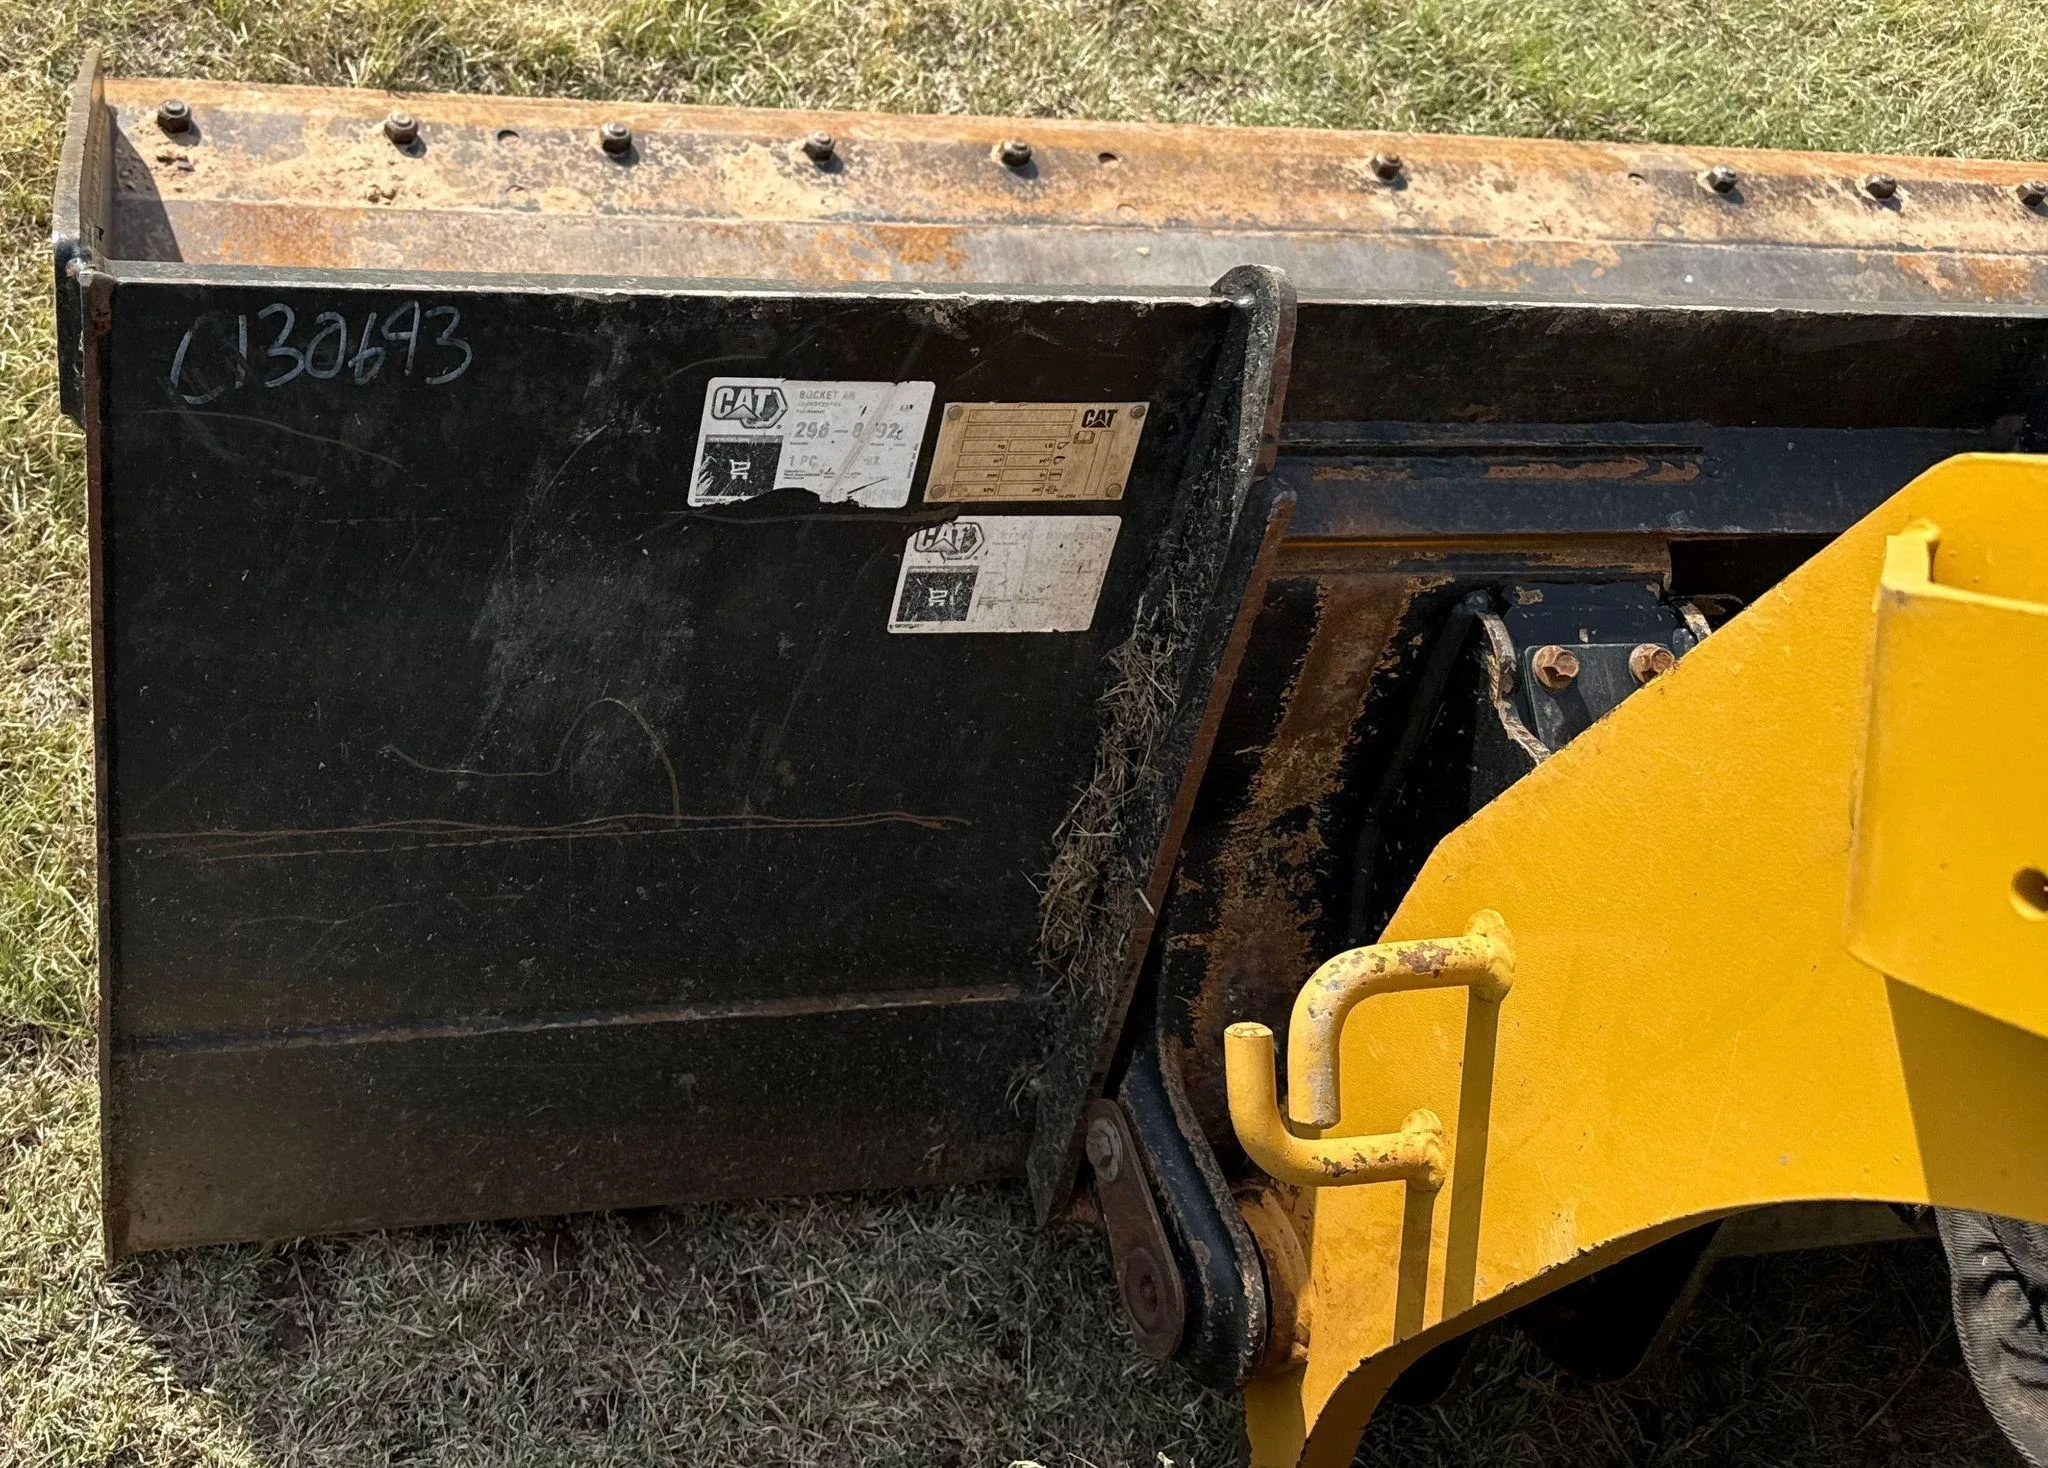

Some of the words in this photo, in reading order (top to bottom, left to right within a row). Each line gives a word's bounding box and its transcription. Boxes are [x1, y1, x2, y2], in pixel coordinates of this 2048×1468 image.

[713, 387, 773, 419] CAT
[799, 390, 839, 400] BUCKET
[1081, 409, 1118, 428] CAT
[915, 523, 971, 552] CAT
